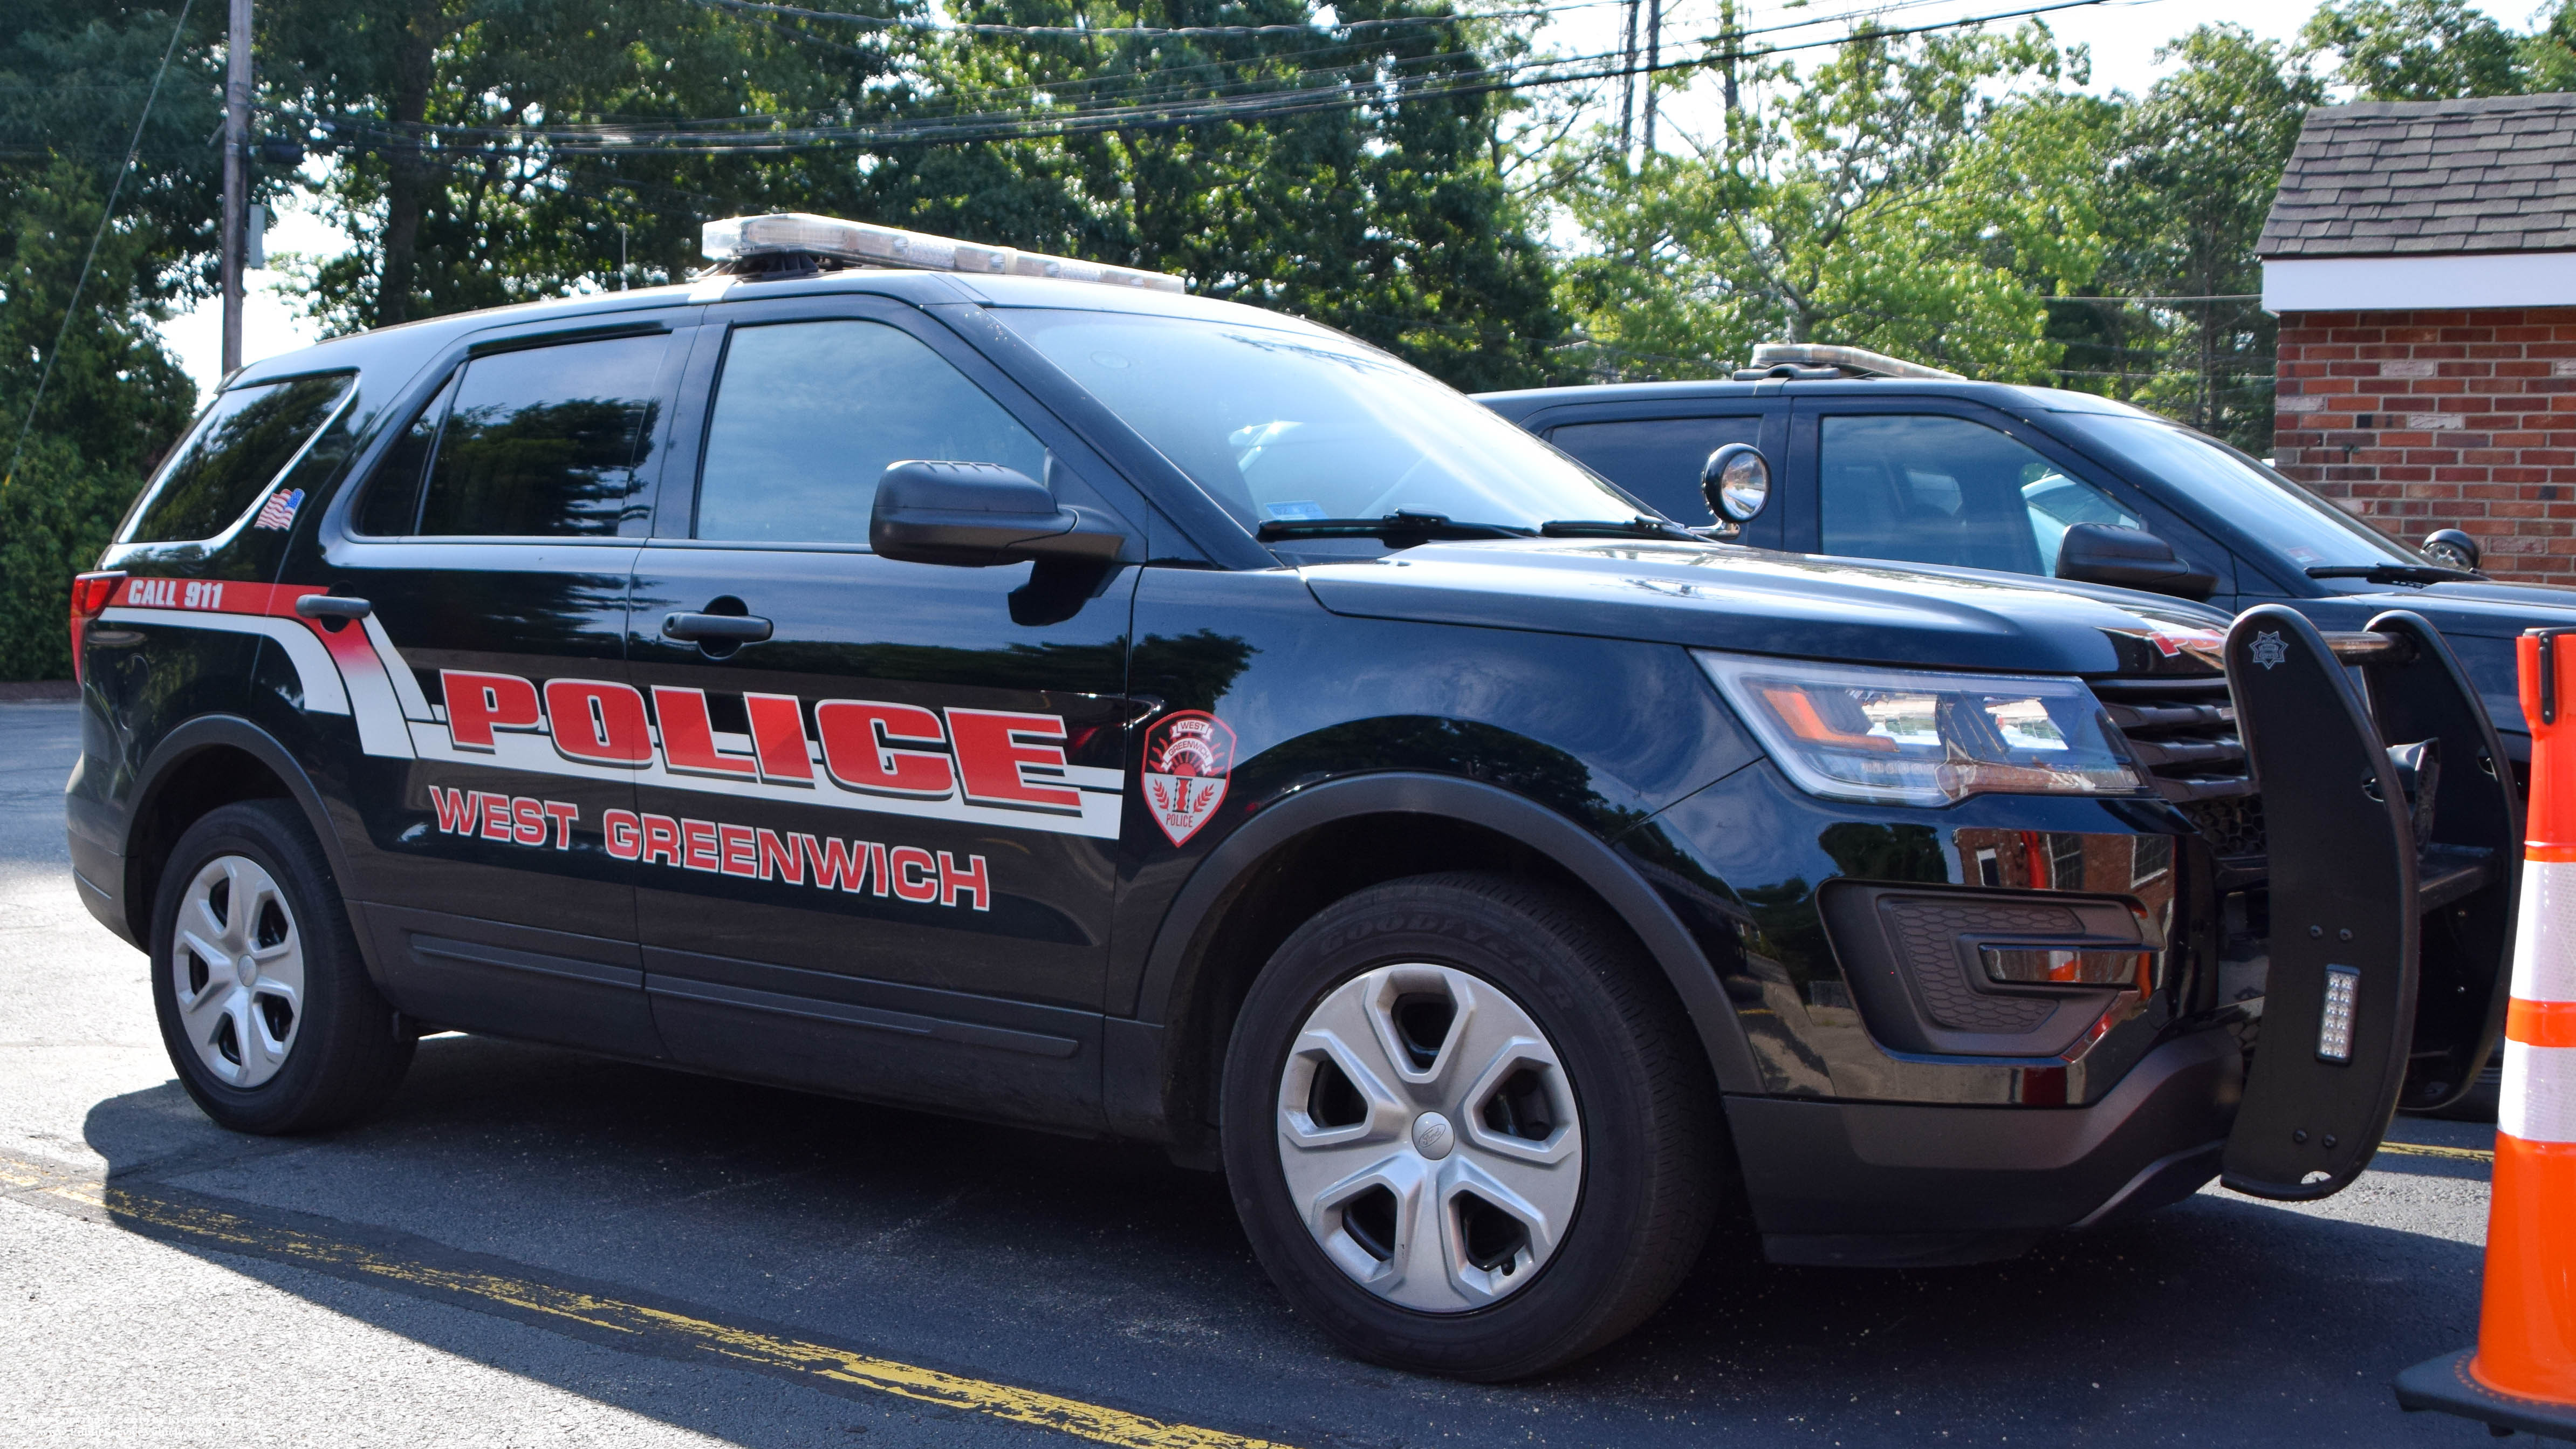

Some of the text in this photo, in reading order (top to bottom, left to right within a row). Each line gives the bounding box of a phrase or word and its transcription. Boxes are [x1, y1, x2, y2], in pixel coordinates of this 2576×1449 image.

[128, 579, 224, 609] CALL 911
[1180, 721, 1206, 731] WEST
[440, 668, 1083, 816] POLICE
[1168, 740, 1210, 760] GREENWICH
[1166, 813, 1194, 828] POLICE
[429, 785, 990, 911] WEST GREENWICH
[1421, 1126, 1442, 1145] Ford
